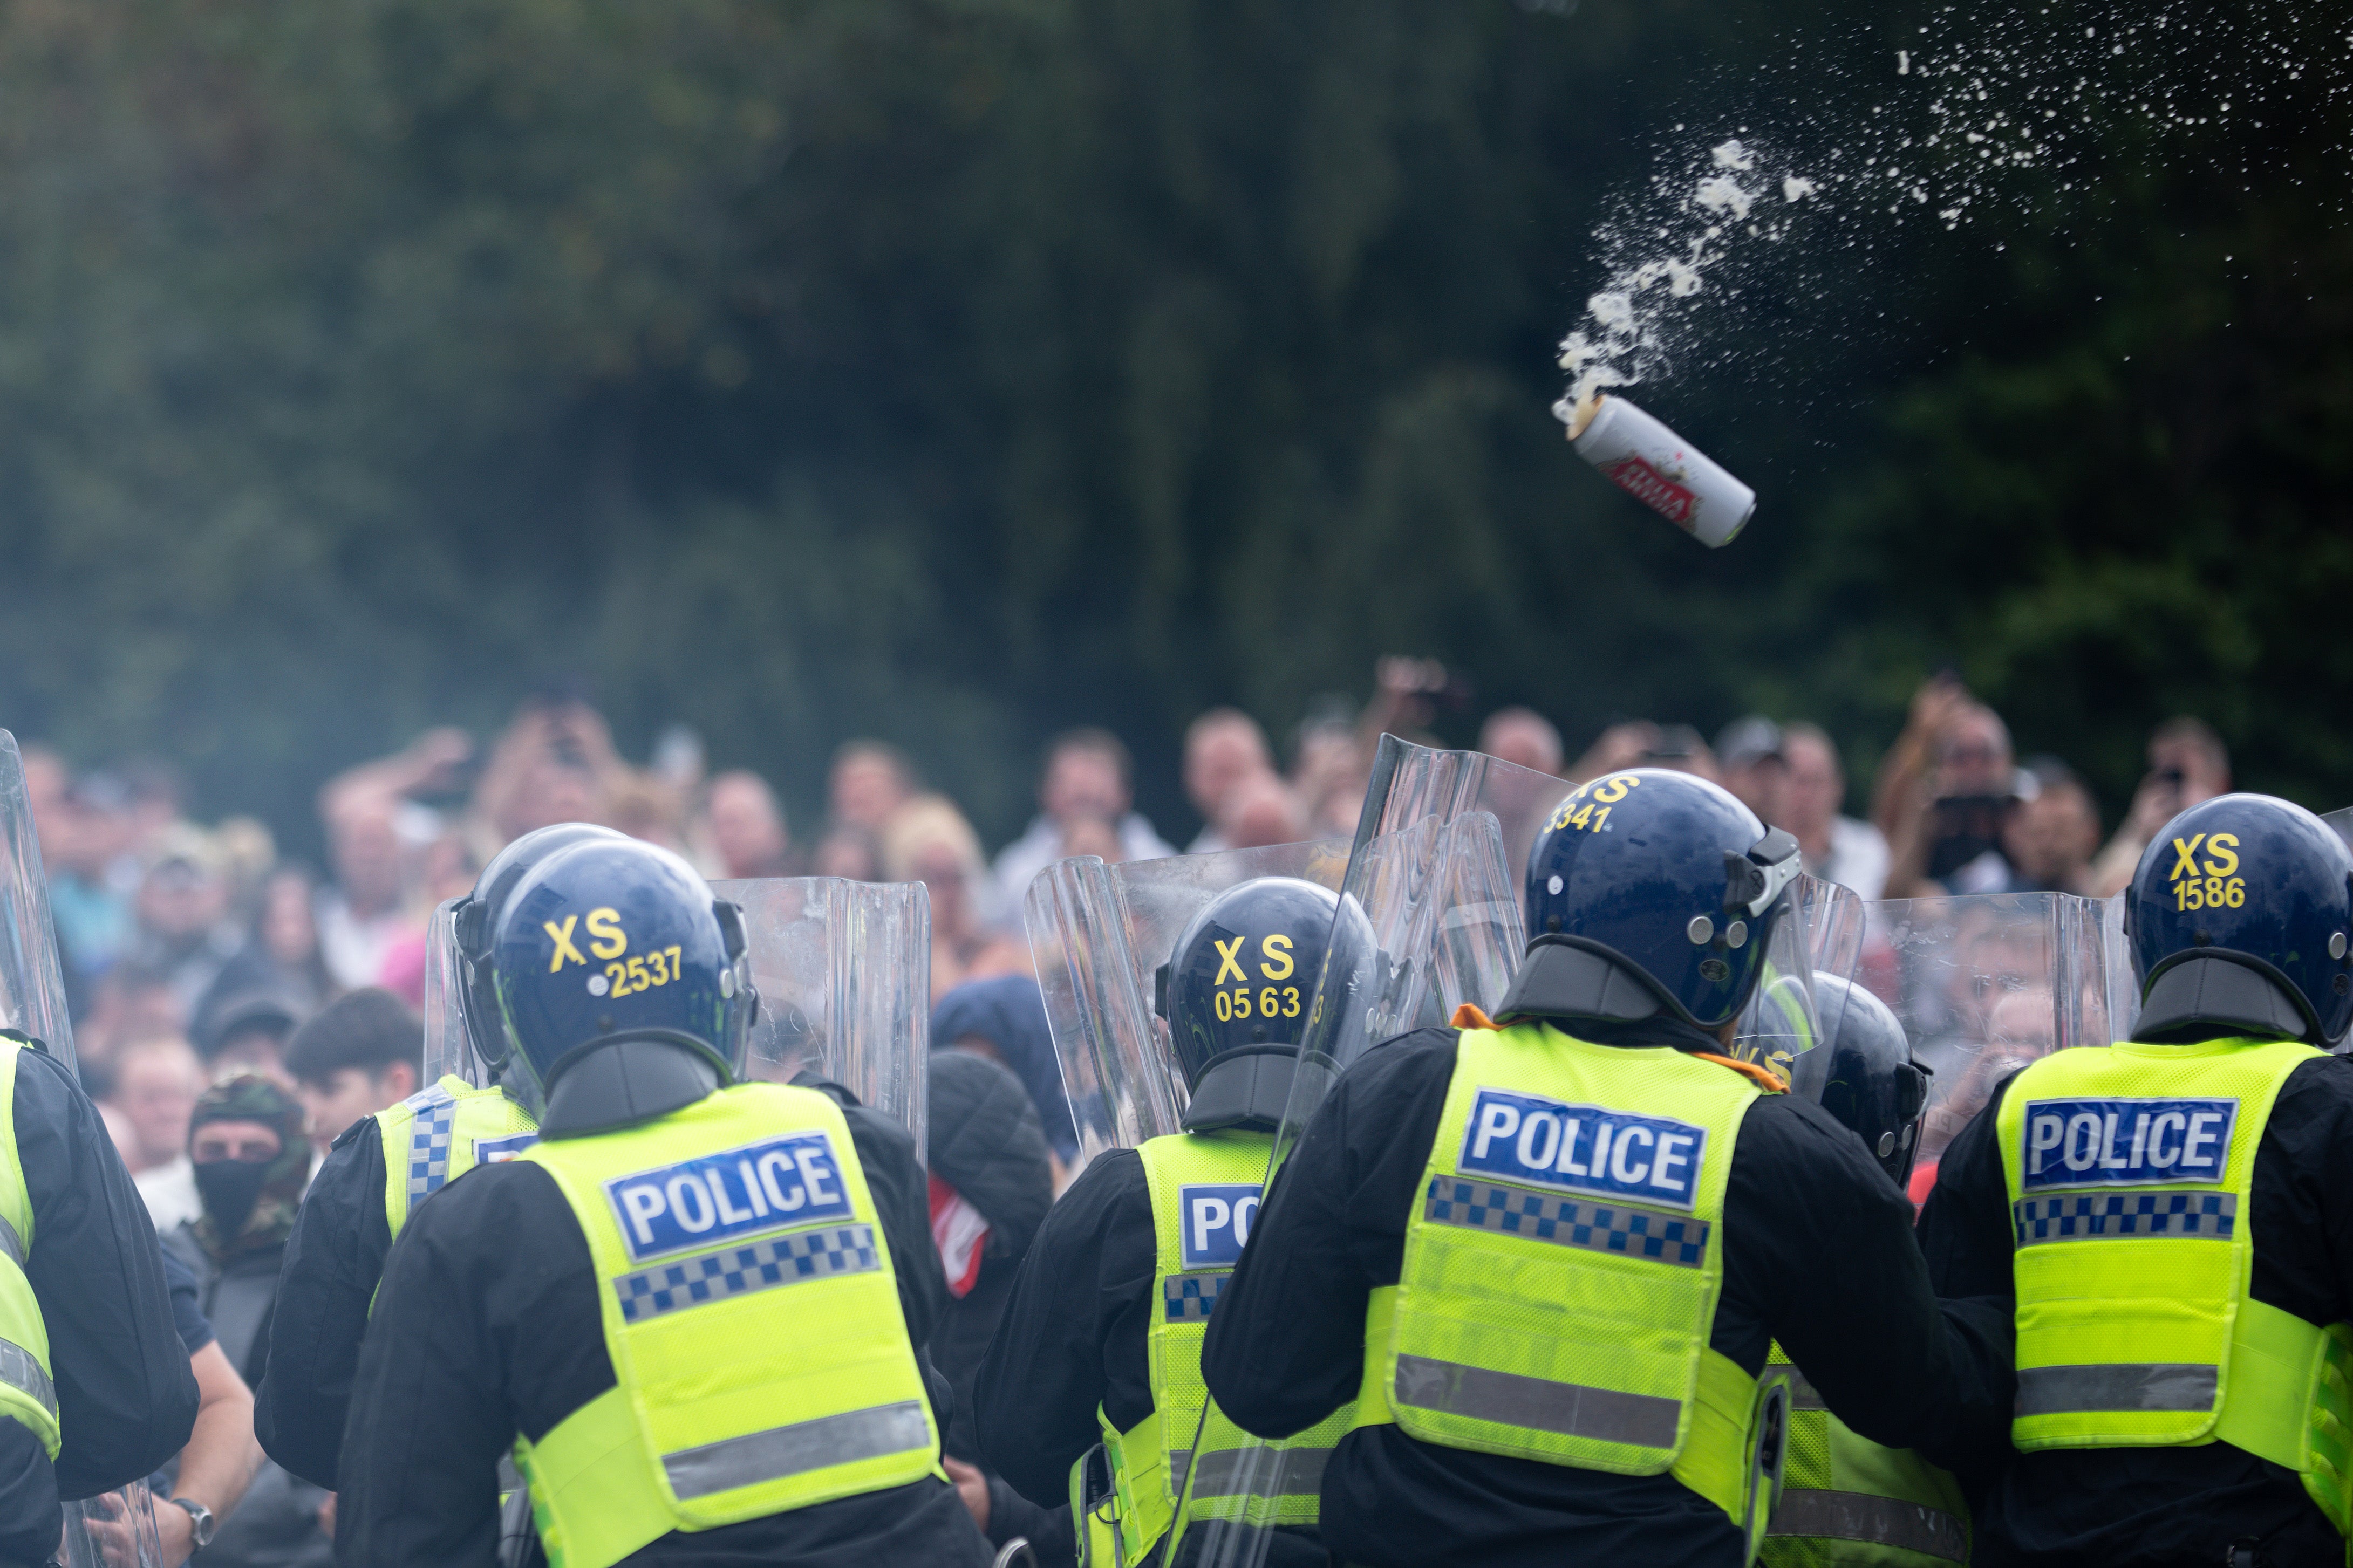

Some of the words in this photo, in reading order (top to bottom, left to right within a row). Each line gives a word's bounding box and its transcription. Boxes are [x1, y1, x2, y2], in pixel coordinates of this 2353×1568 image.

[2170, 833, 2240, 881] XS
[2173, 877, 2245, 912] 1586
[544, 908, 628, 974] XS
[606, 946, 683, 999] 2537
[1471, 1103, 1694, 1191] POLICE
[2030, 1112, 2222, 1174] POLICE
[620, 1147, 842, 1244] POLICE
